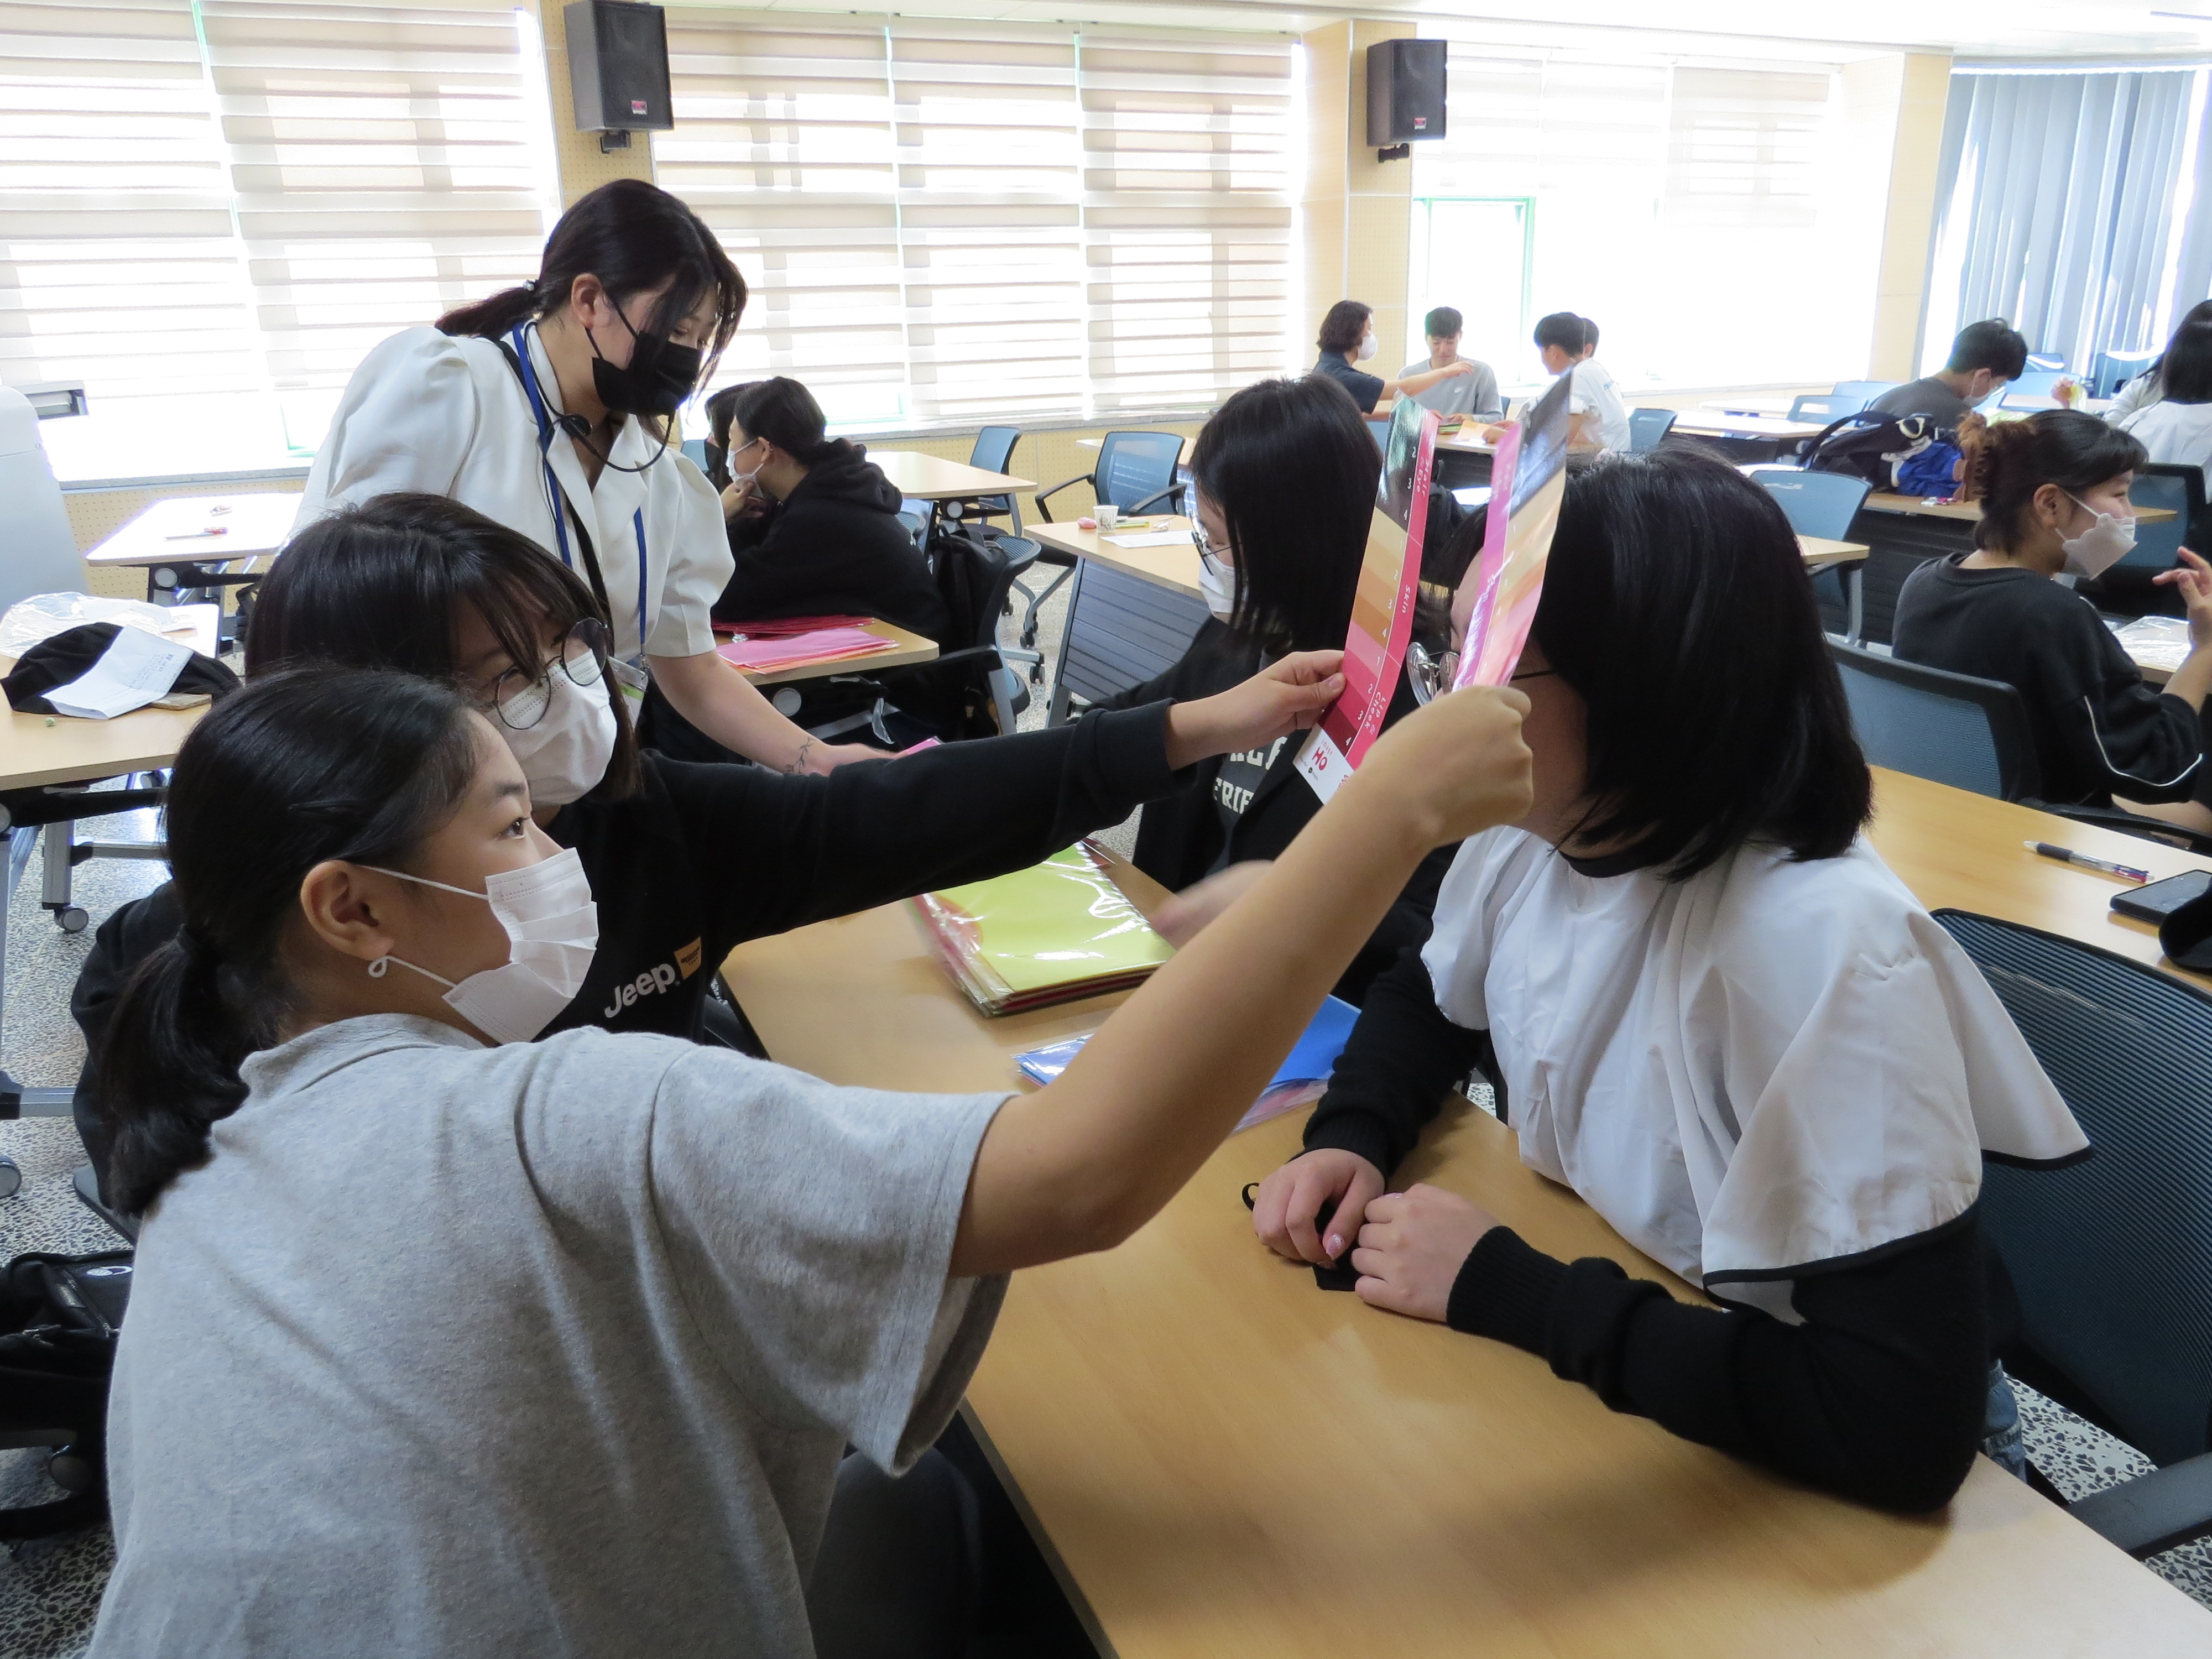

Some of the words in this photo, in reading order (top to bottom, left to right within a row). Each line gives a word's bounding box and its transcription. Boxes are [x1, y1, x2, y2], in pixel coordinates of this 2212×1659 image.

[1412, 446, 1416, 458] 2
[1407, 478, 1412, 489] 3
[1404, 510, 1408, 520] 4
[1394, 570, 1398, 581] 2
[1388, 598, 1392, 609] 3
[1402, 585, 1410, 613] Skin
[1383, 628, 1387, 638] 4
[1368, 684, 1373, 693] 2
[1365, 692, 1381, 728] Cheek
[1376, 697, 1386, 718] Lip
[1358, 710, 1363, 720] 3
[1345, 737, 1352, 746] 4
[604, 963, 675, 1018] Jeep
